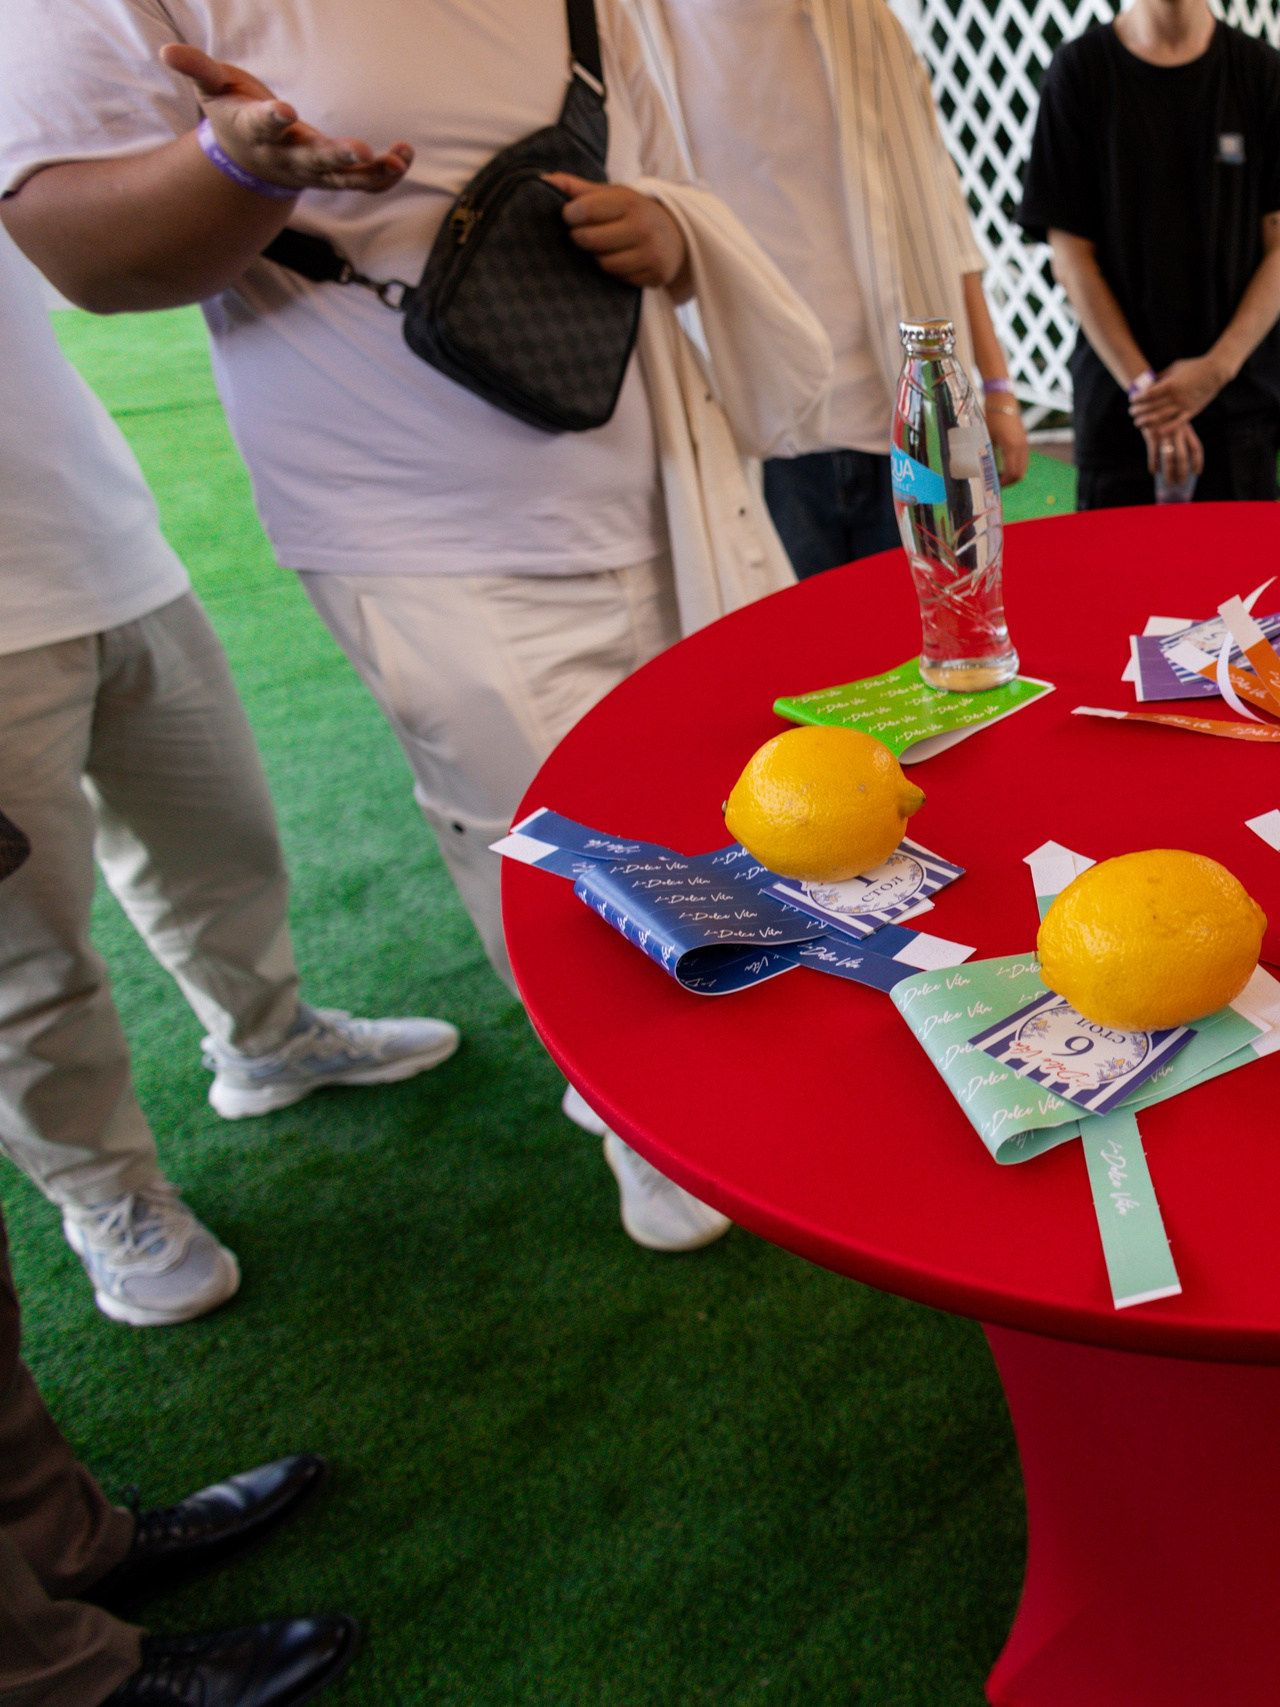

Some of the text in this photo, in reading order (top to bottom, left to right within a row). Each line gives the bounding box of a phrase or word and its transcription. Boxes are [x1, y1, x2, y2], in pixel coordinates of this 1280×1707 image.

[861, 876, 904, 903] СТОЛ
[946, 973, 971, 990] Vita
[922, 1010, 963, 1041] Dolce
[967, 1001, 993, 1018] Vita
[965, 1071, 1008, 1104] Dolce
[990, 1105, 1034, 1137] Dolce
[1038, 1093, 1065, 1115] Vita
